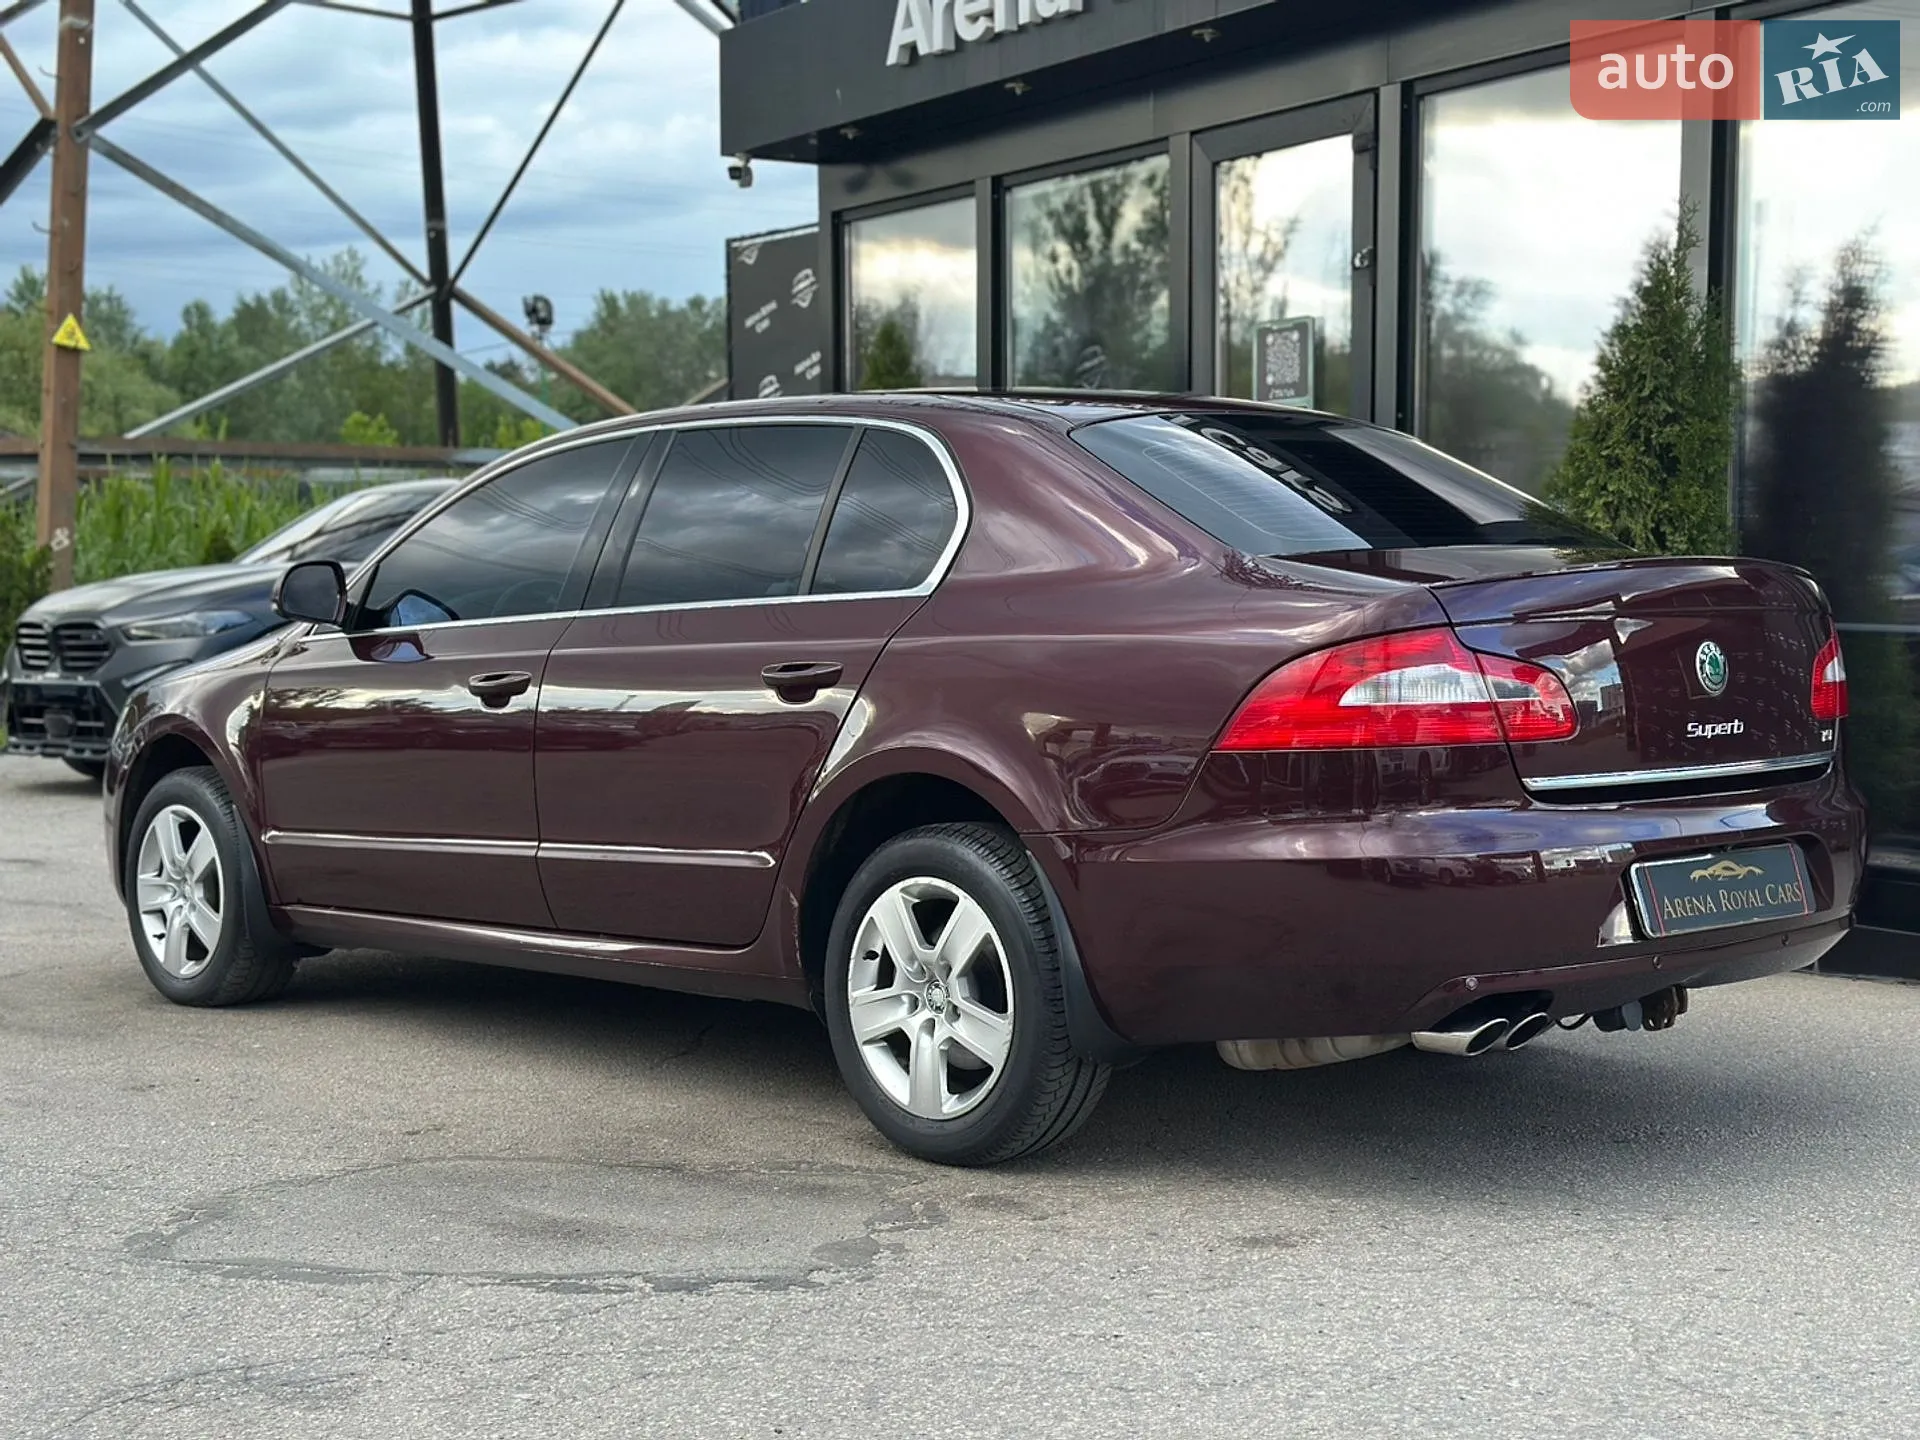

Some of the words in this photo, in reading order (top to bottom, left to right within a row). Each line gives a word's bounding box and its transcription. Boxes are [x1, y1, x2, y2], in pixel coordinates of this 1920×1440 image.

[1686, 719, 1744, 739] Superb
[1663, 895, 1717, 920] ARENA
[1718, 888, 1765, 912] ROYAL
[1765, 883, 1803, 905] CARS
